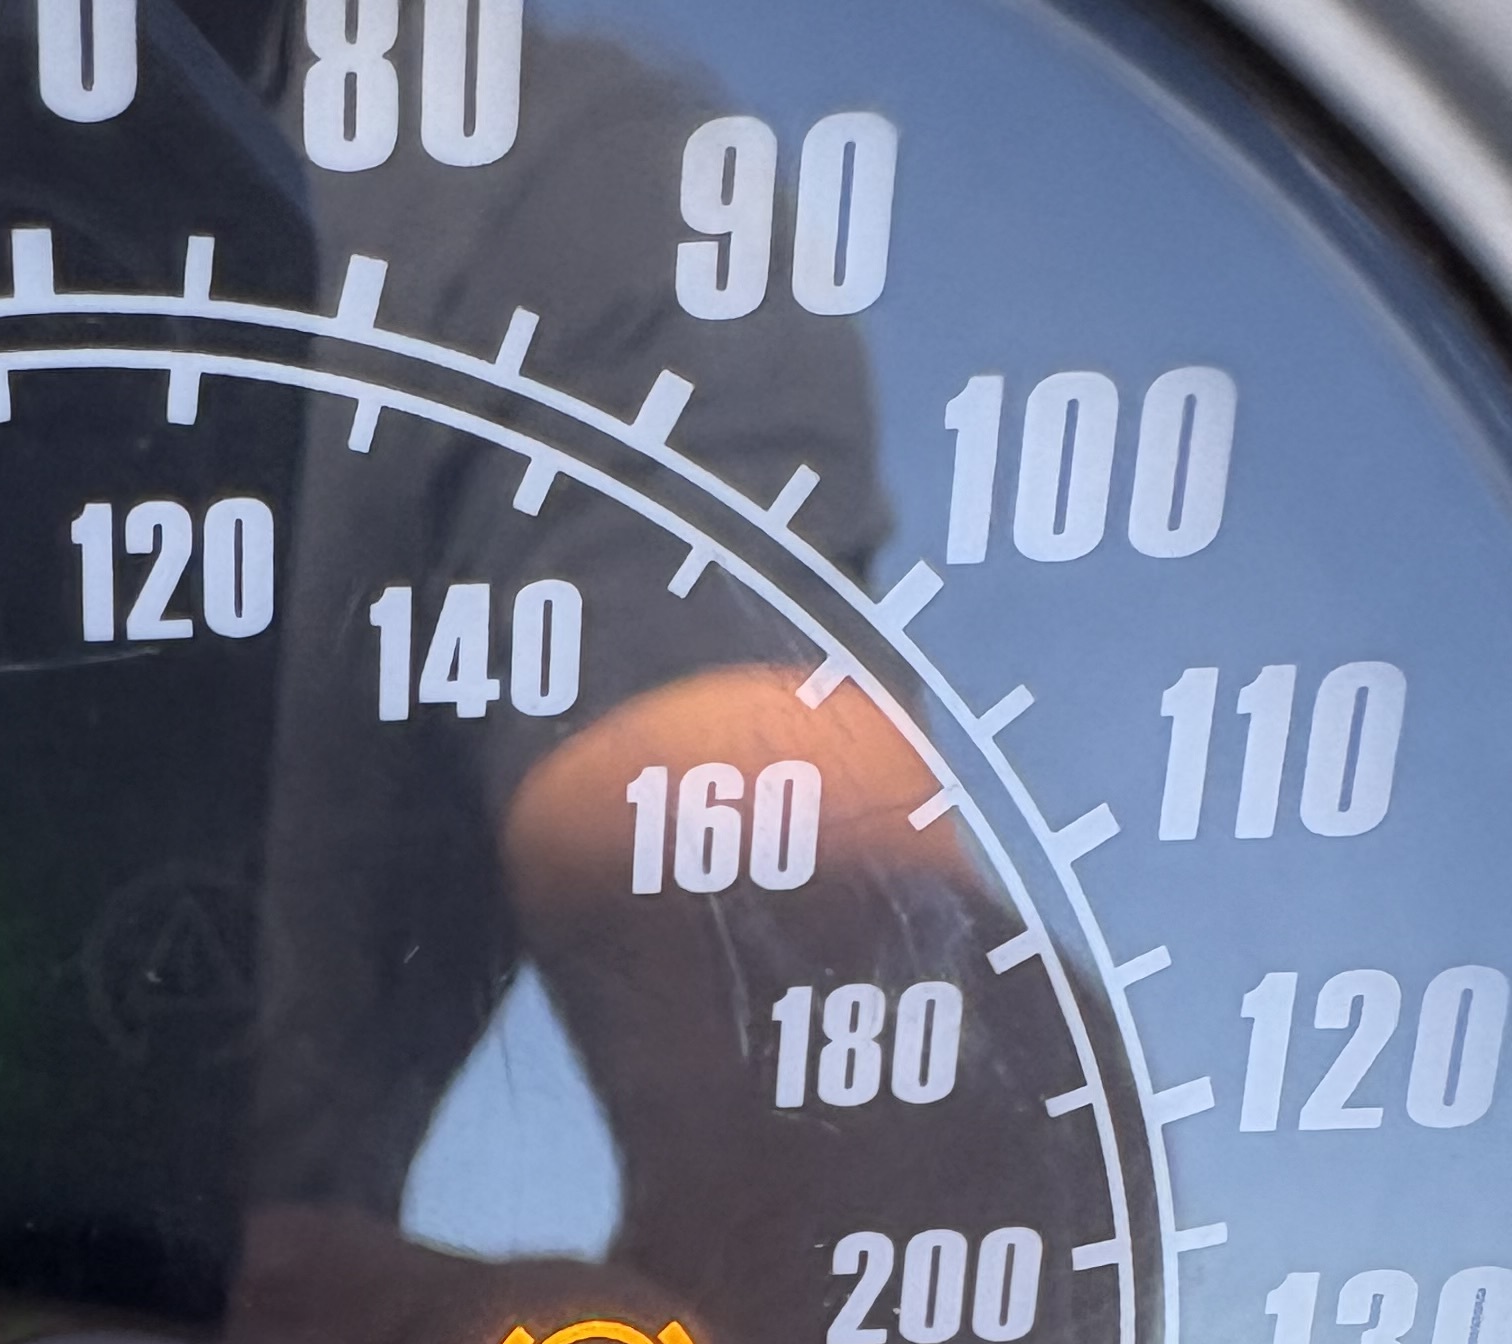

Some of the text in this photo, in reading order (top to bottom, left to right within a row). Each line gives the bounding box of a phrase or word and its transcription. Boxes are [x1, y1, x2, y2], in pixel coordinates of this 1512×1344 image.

[303, 0, 522, 172] 80
[675, 111, 898, 320] 90
[945, 366, 1237, 564] 100
[71, 497, 274, 642] 120
[369, 579, 583, 720] 140
[626, 760, 822, 895] 160
[1158, 661, 1407, 841] 110
[771, 982, 962, 1108] 180
[1238, 965, 1509, 1132] 120
